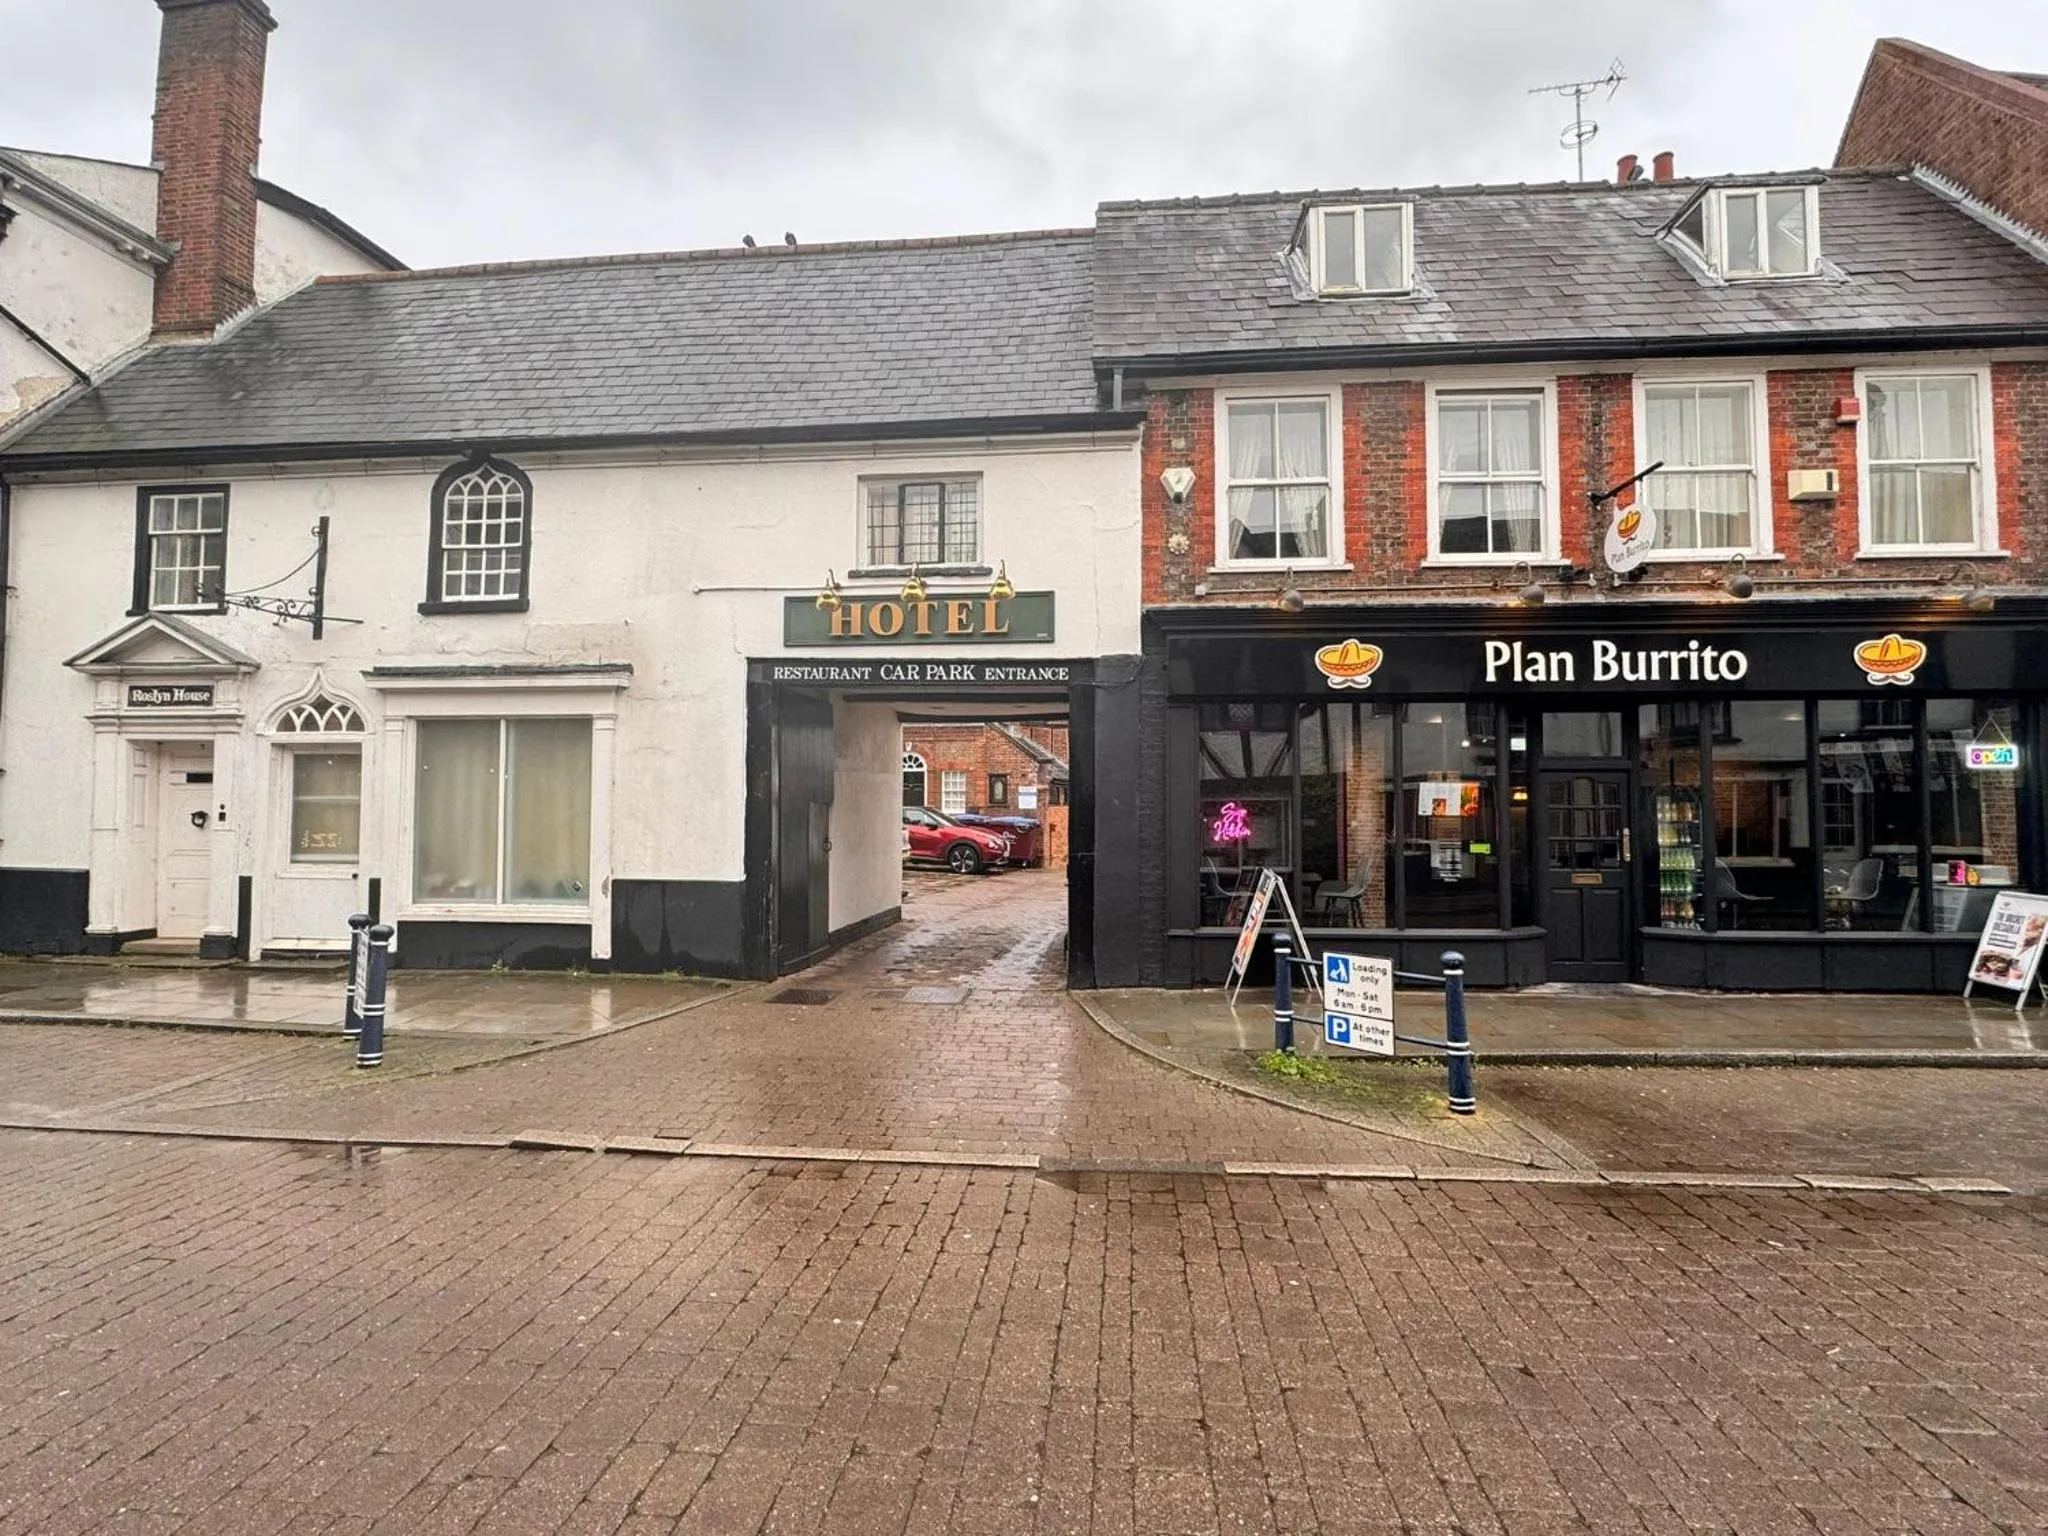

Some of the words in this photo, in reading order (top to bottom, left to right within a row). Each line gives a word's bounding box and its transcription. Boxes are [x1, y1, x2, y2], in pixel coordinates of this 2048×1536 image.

[829, 600, 1009, 637] HOTEL
[1485, 640, 1575, 682] Plan
[1592, 639, 1749, 682] Burrito
[774, 666, 871, 681] RESTAURANT
[880, 664, 920, 681] CAR
[926, 664, 976, 681] PARK
[985, 667, 1069, 681] ENTRANCE
[132, 689, 171, 703] Roslyn
[173, 688, 210, 702] House
[1971, 747, 2013, 765] open
[1353, 963, 1387, 976] Loading
[1360, 976, 1379, 985] only
[1338, 988, 1355, 998] Mon
[1363, 992, 1378, 1001] Sat
[1333, 1018, 1347, 1039] P
[1353, 1023, 1363, 1031] At
[1366, 1026, 1390, 1036] other
[1360, 1035, 1383, 1046] times
